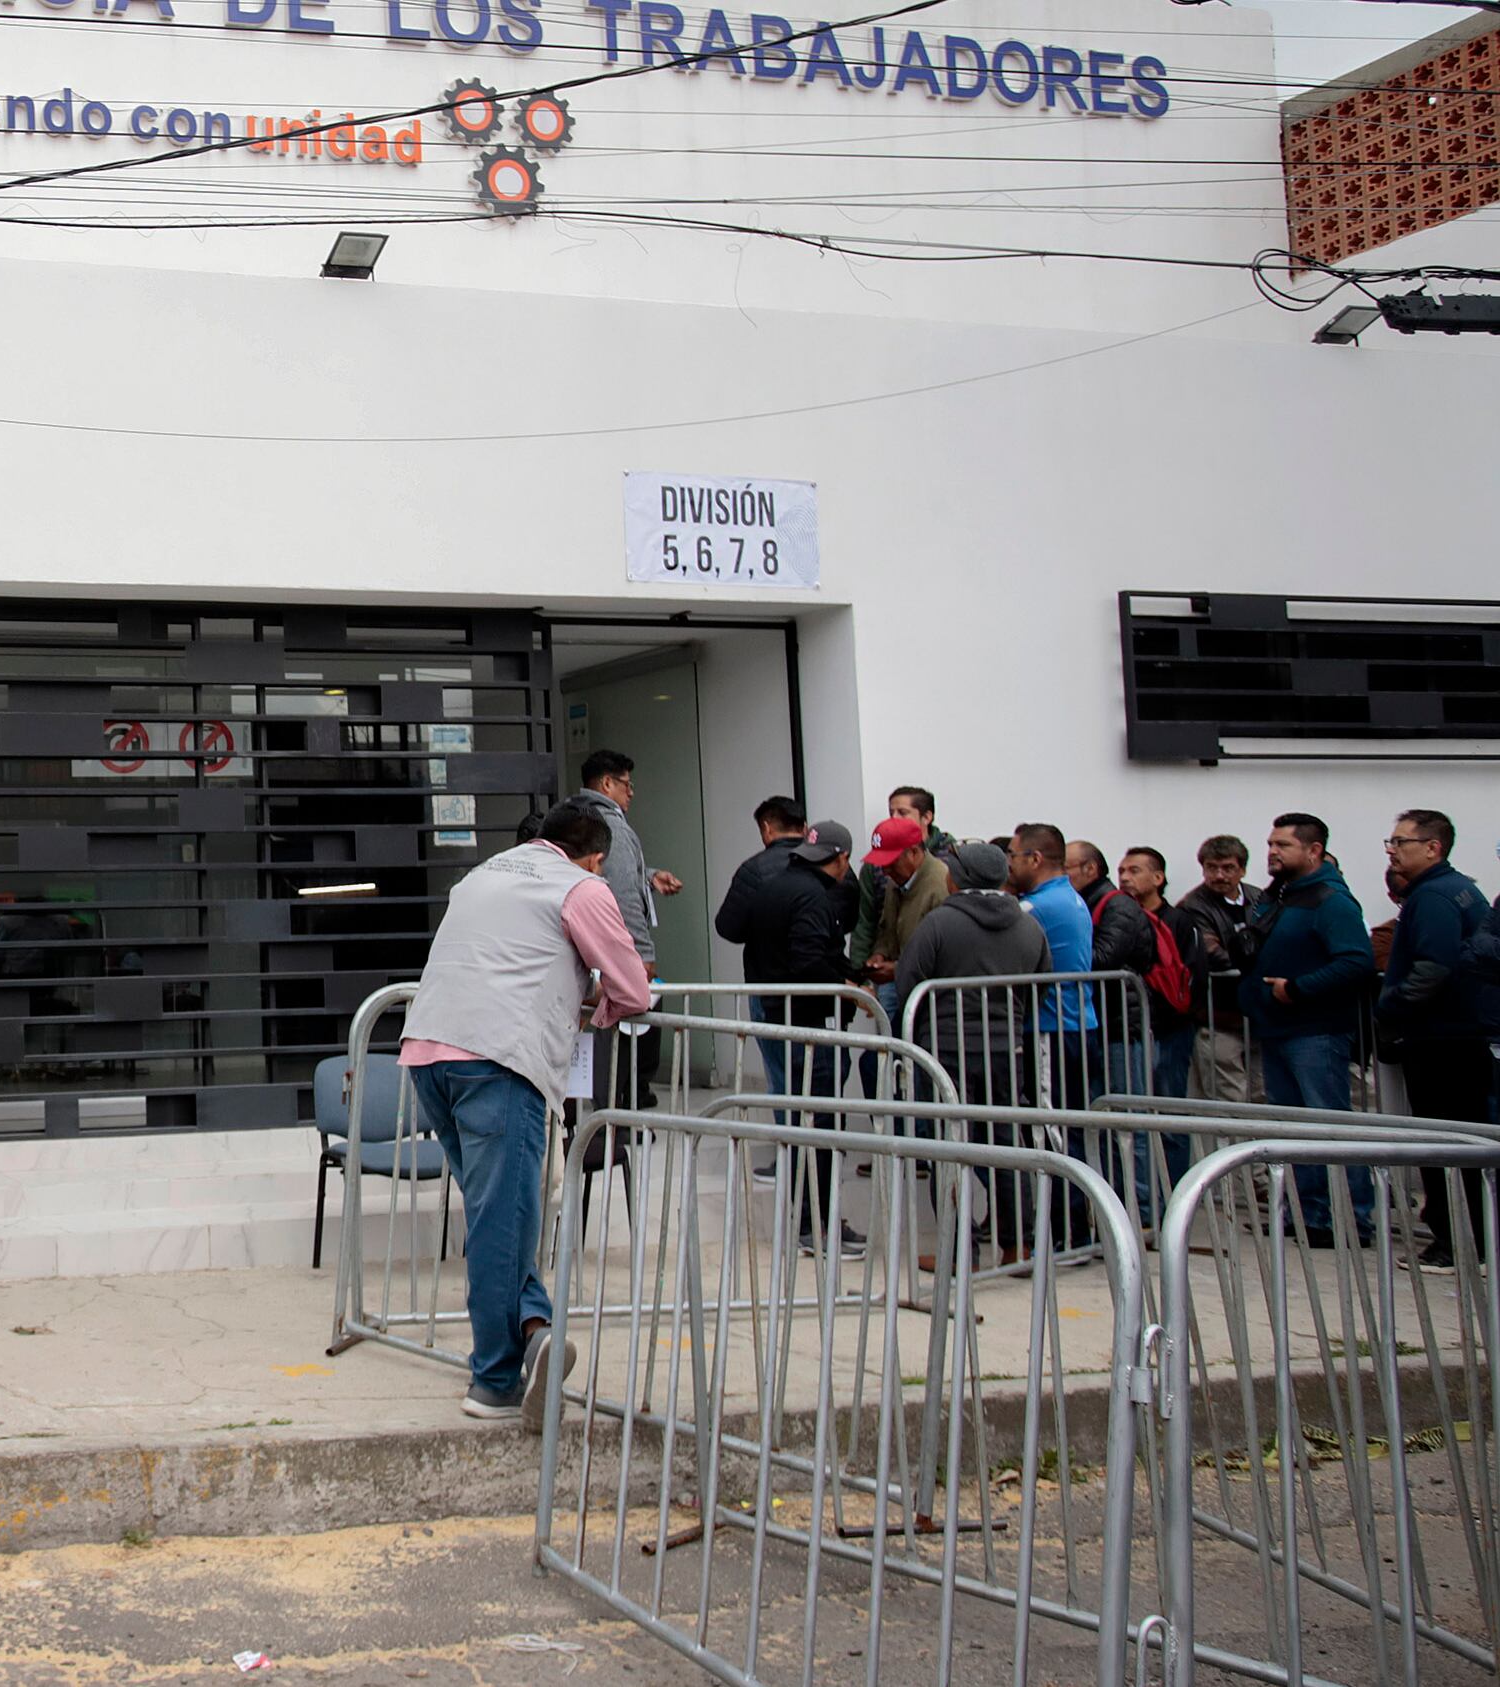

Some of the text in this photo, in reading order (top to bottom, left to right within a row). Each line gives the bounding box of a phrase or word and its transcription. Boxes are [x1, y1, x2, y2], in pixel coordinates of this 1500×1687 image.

[387, 0, 543, 53] LOS
[586, 0, 1171, 118] TRABAJADORES
[129, 103, 232, 147] con
[245, 109, 422, 165] unidad
[660, 483, 776, 528] DIVISIÓN
[662, 534, 779, 580] 5, 6, 7, 8
